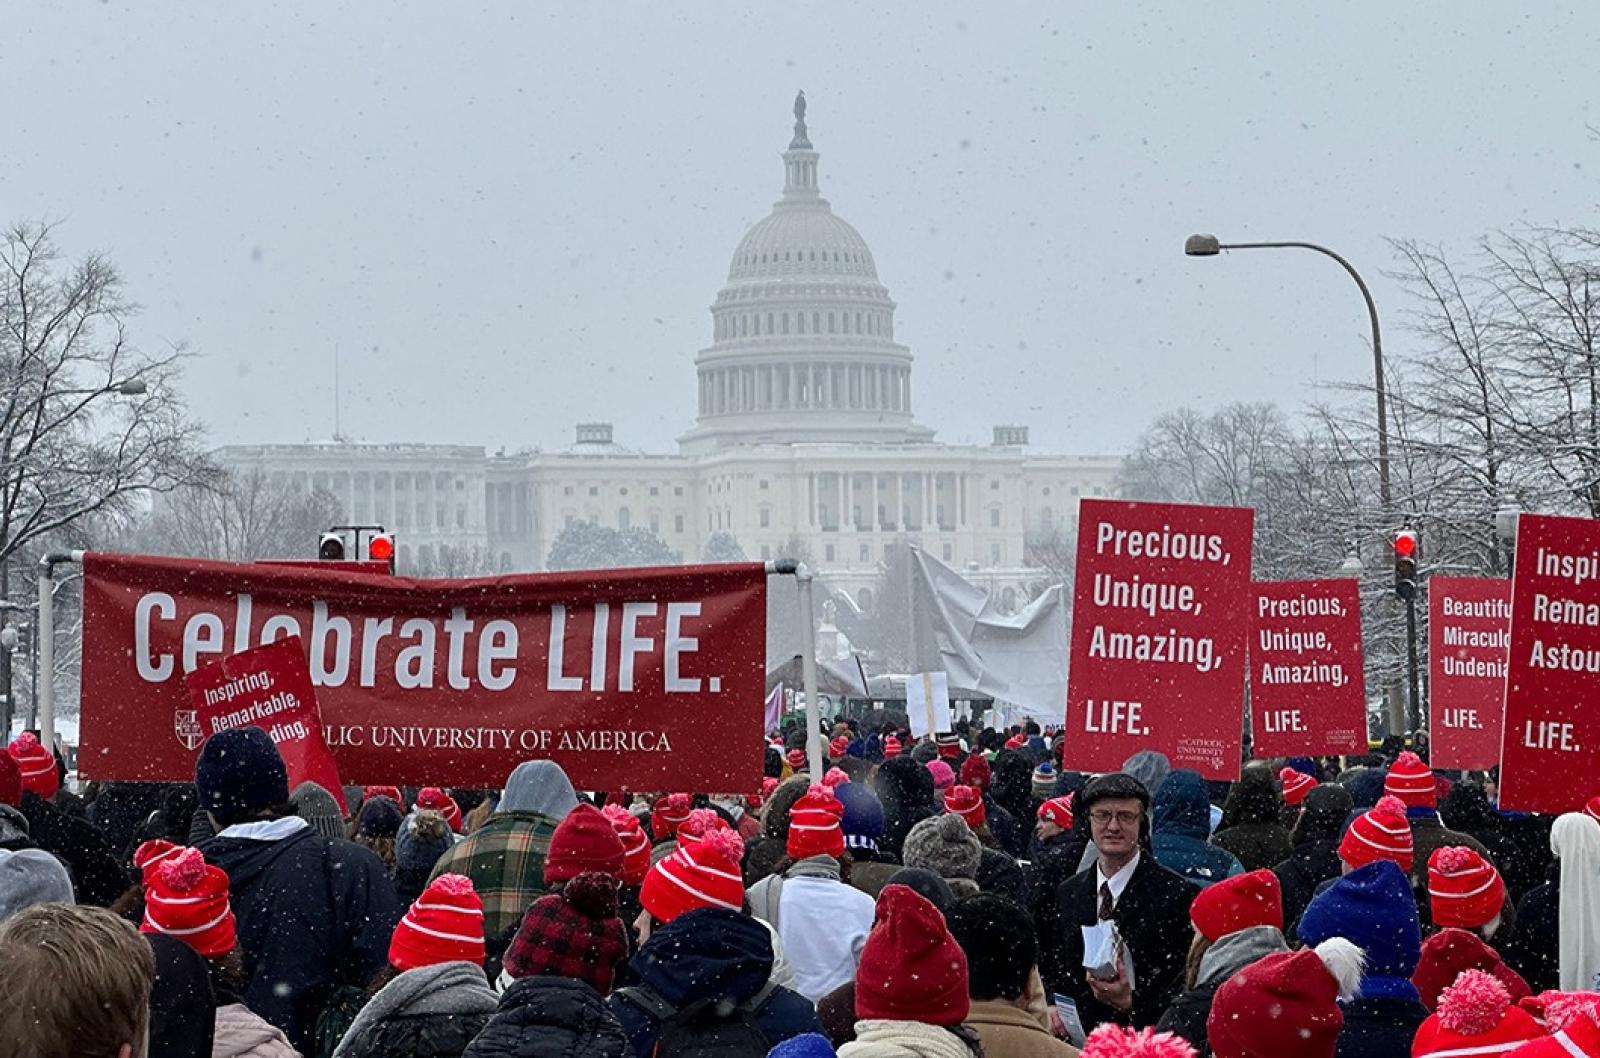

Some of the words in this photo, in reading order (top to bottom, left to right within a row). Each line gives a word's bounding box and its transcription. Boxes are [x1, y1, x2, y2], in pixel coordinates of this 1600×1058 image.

[1096, 522, 1231, 565] Precious,
[1093, 574, 1203, 617] Unique,
[1258, 593, 1347, 618] Precious,
[547, 602, 722, 693] LIFE.
[1089, 625, 1222, 672] Amazing,
[1260, 628, 1332, 654] Unique,
[204, 671, 274, 706] Inspiring,
[1262, 660, 1349, 687] Amazing,
[210, 691, 300, 735] Remarkable,
[1085, 699, 1150, 736] LIFE.
[1264, 709, 1308, 732] LIFE.
[1443, 708, 1483, 729] LIFE.
[371, 725, 515, 750] UNIVERSITY
[519, 729, 552, 750] OF
[557, 730, 672, 752] AMERICA
[1525, 720, 1580, 752] LIFE.
